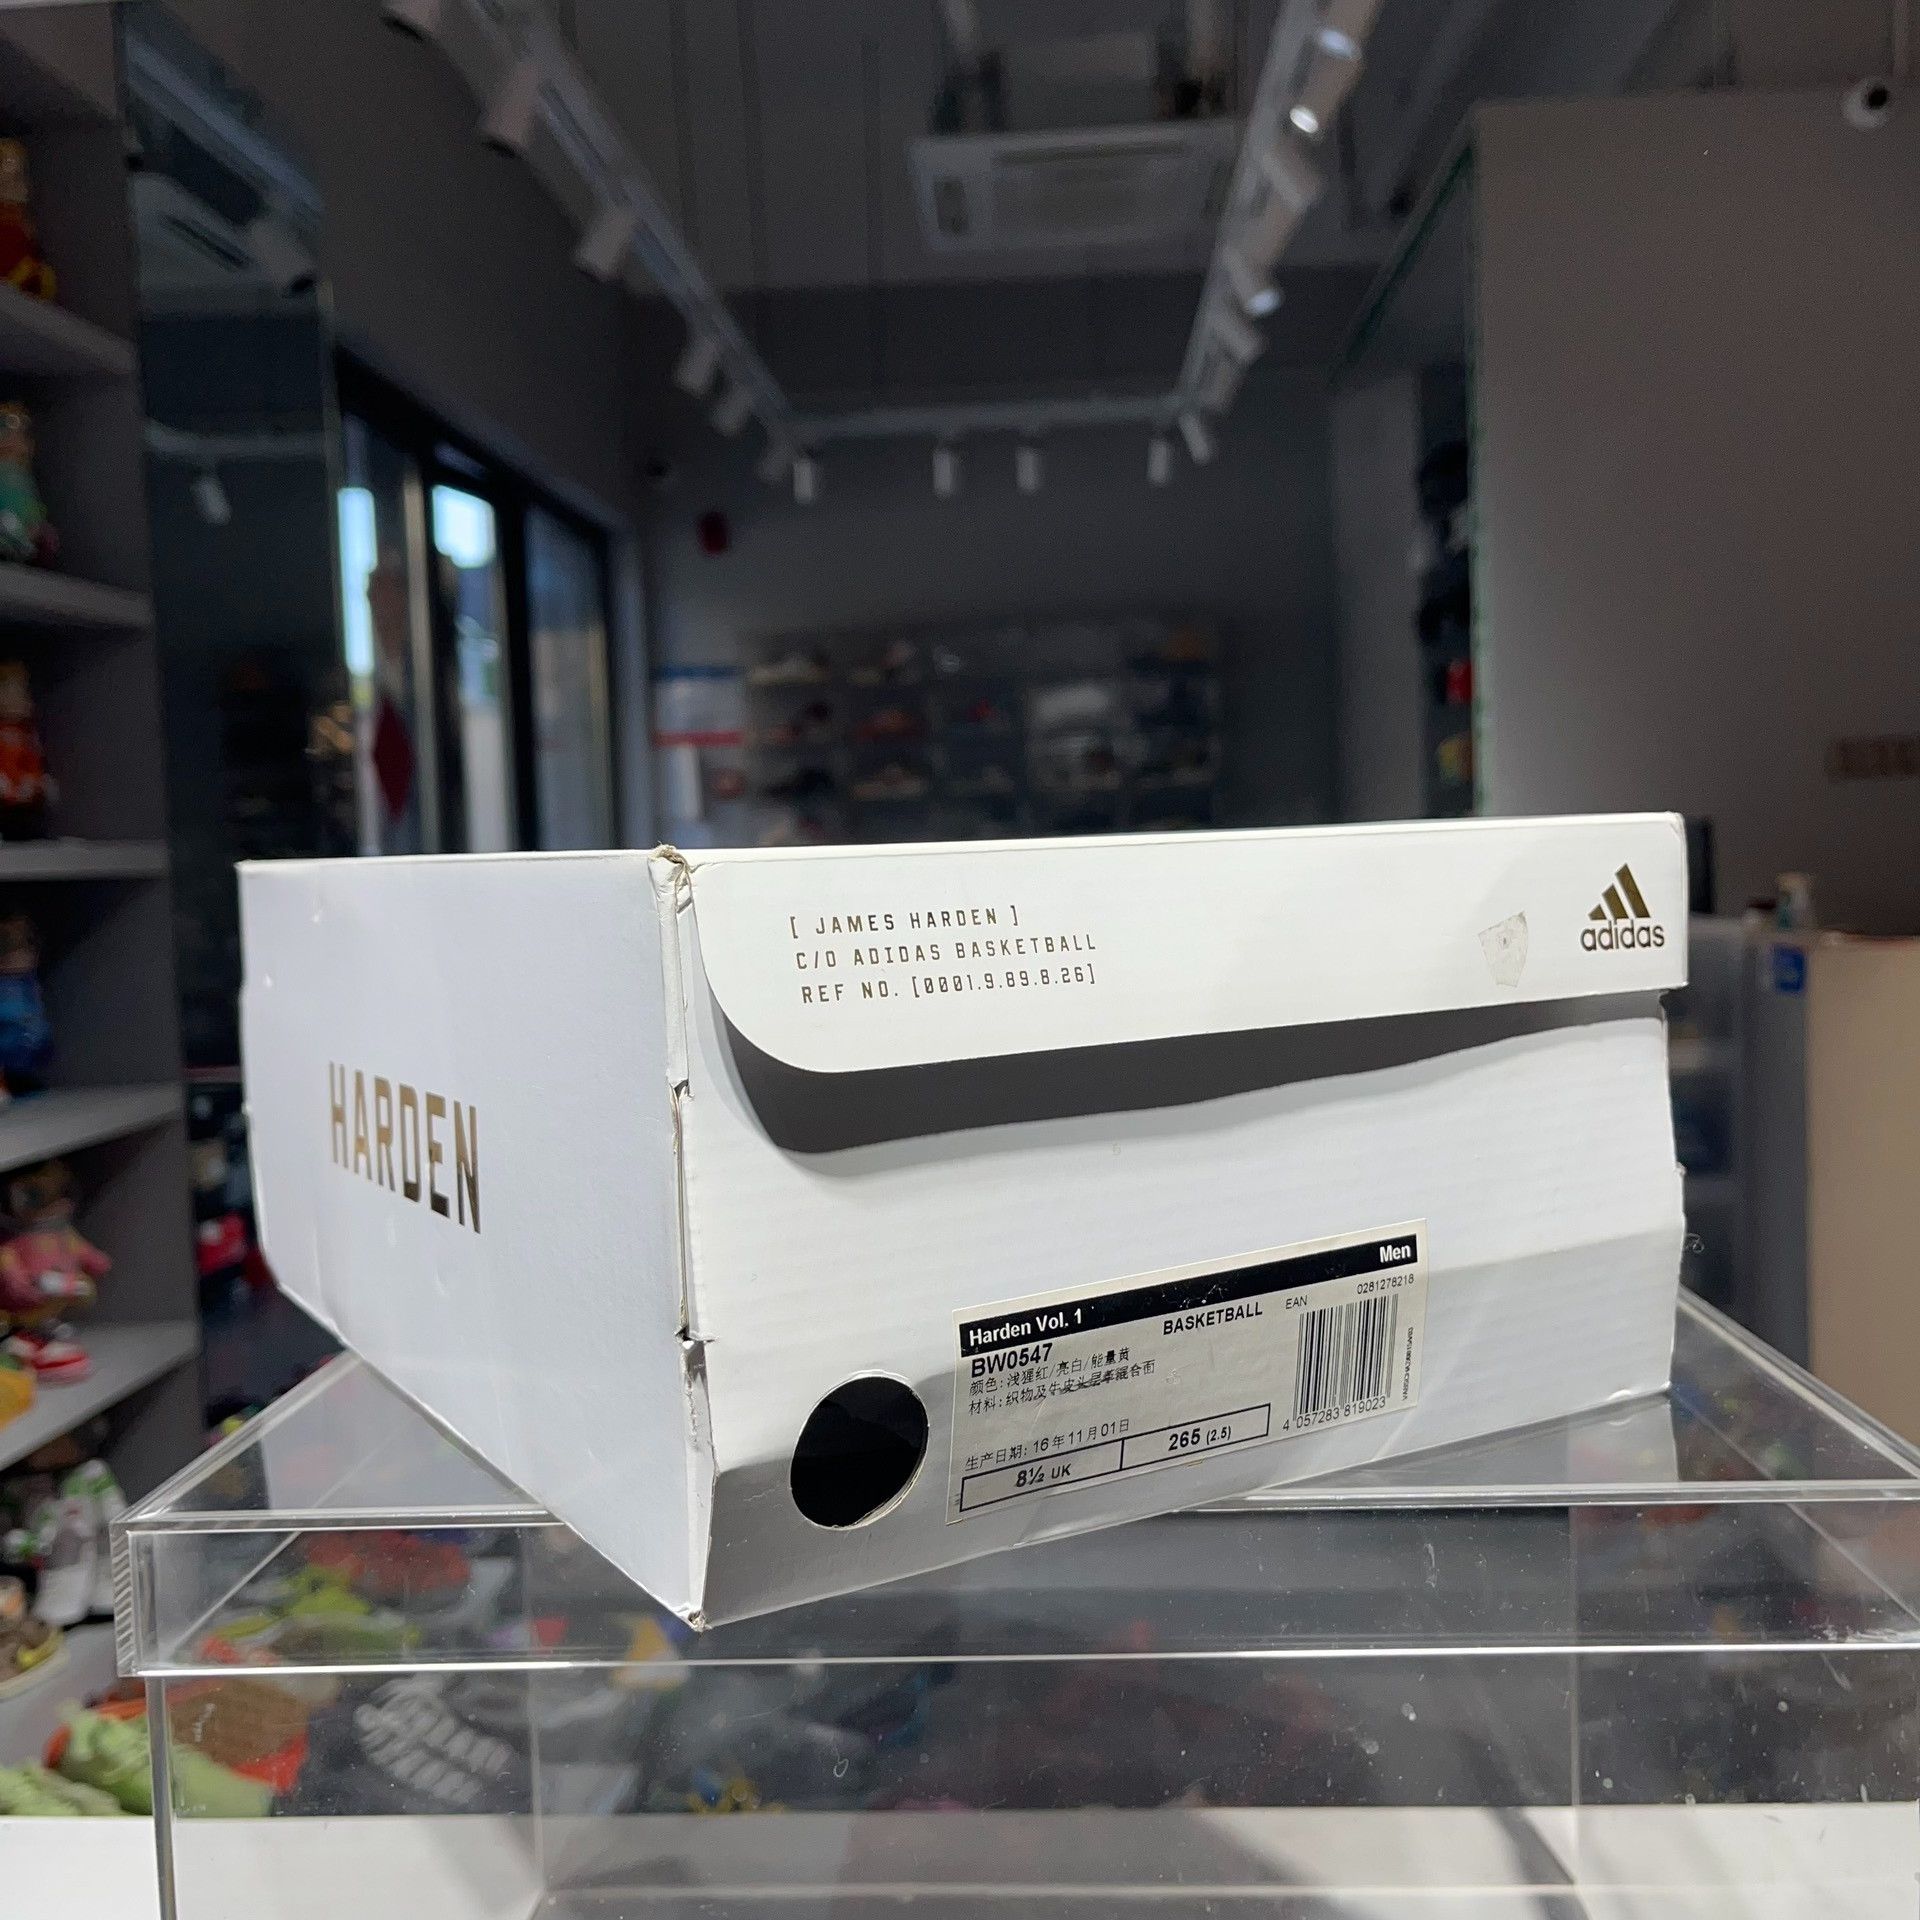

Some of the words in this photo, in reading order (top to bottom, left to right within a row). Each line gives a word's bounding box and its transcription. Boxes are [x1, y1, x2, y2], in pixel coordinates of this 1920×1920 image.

[815, 913, 895, 935] JAMES
[909, 907, 998, 930] HARDEN
[1580, 919, 1665, 952] adidas
[796, 949, 837, 970] C/O
[853, 943, 941, 966] ADIDAS
[955, 934, 1097, 959] BASKETBALL
[801, 983, 844, 1004] REF
[861, 980, 899, 999] NO.
[911, 963, 1096, 998] [0001.9.89.8.26]
[329, 1060, 481, 1235] HARDEN
[1379, 1243, 1412, 1263] Men
[1356, 1273, 1415, 1295] 0281278218
[1162, 1301, 1263, 1335] BASKETBALL
[1285, 1295, 1308, 1310] EAN
[969, 1319, 1031, 1347] Harden
[1035, 1312, 1069, 1332] Vol.
[1073, 1308, 1082, 1325] 1
[971, 1342, 1053, 1378] BW0547
[1296, 1406, 1340, 1429] 057283
[1343, 1396, 1386, 1417] 819023
[1168, 1428, 1201, 1451] 265
[1206, 1424, 1232, 1445] (2.5)
[1051, 1463, 1071, 1480] UK
